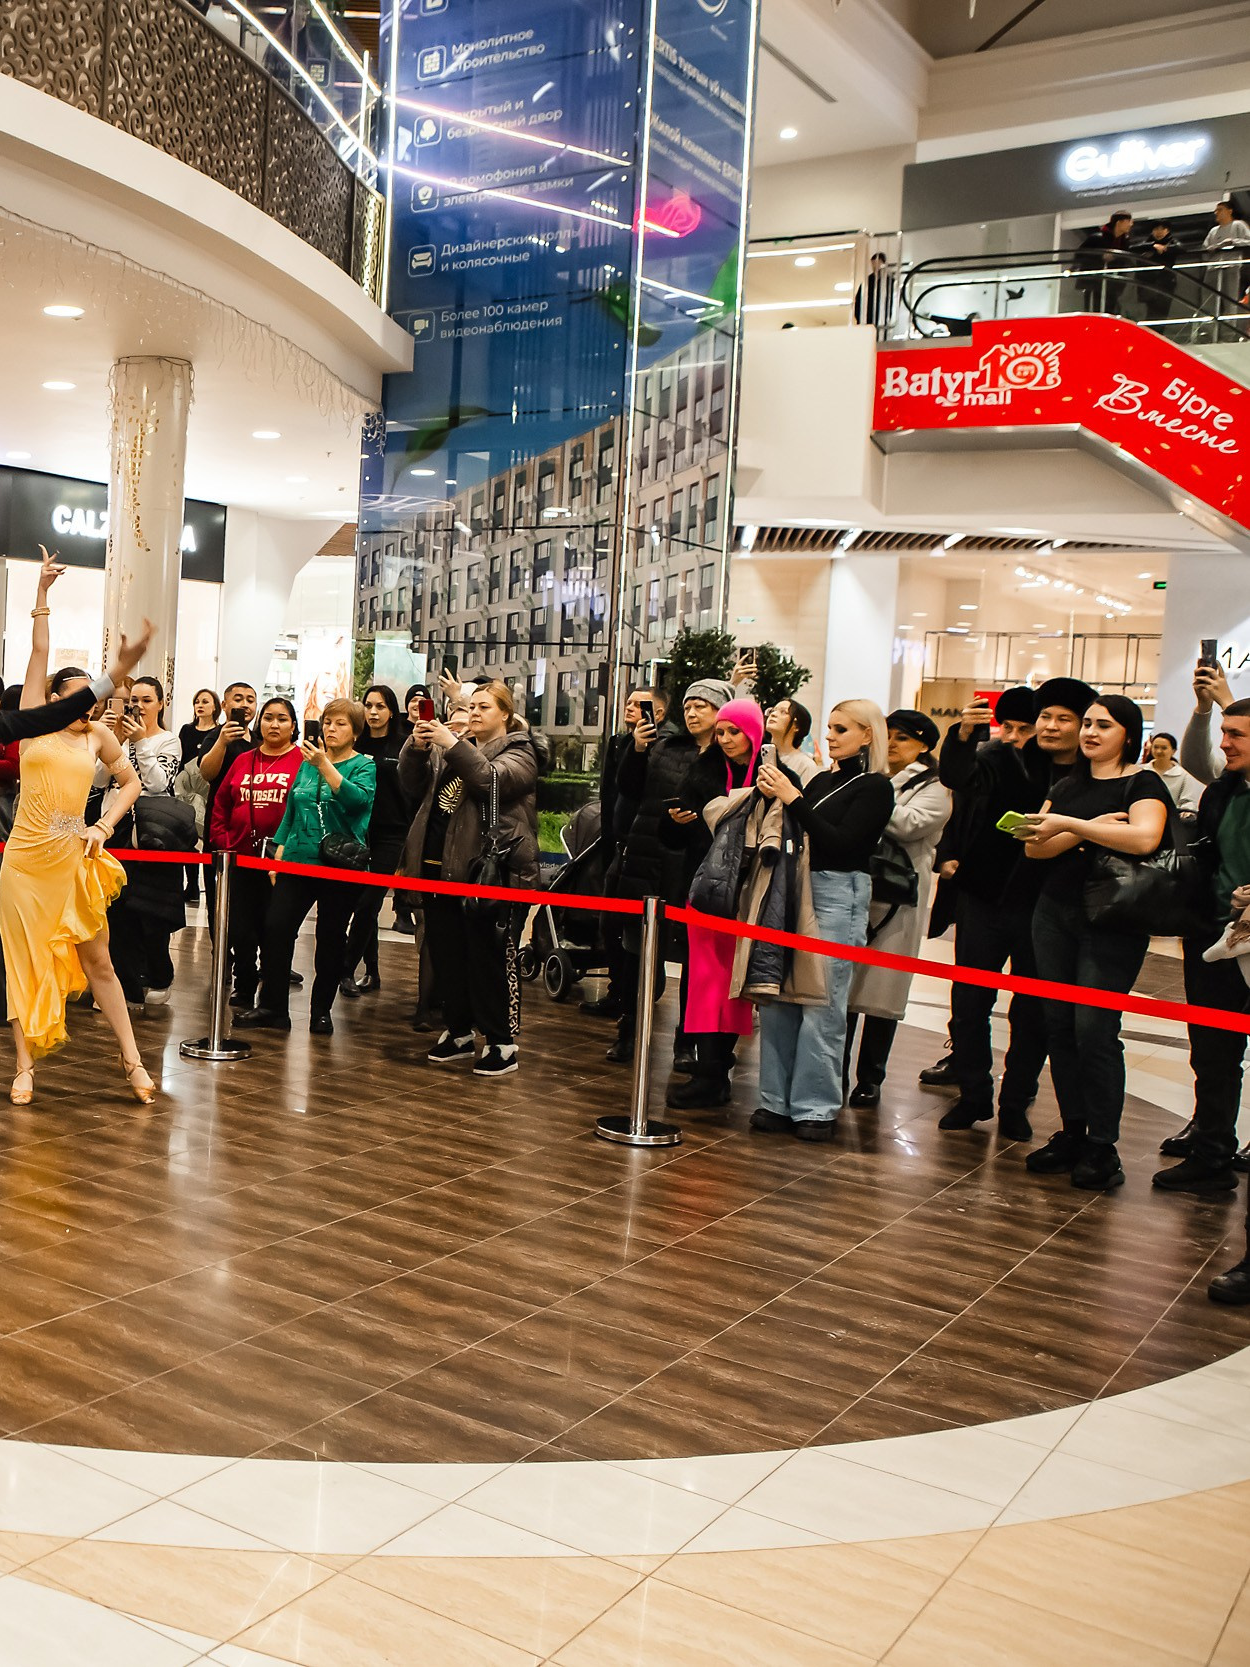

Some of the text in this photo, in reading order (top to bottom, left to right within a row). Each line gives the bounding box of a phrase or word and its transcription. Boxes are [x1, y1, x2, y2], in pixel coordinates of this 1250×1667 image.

[451, 29, 535, 56] Монолитное
[449, 99, 524, 124] крытый и
[447, 109, 563, 140] безосный двор
[1065, 138, 1206, 182] Gulliver
[462, 164, 536, 186] домофония
[539, 163, 548, 174] и
[532, 176, 574, 192] замки
[441, 252, 530, 272] и колясочные
[441, 301, 549, 322] Более 100 камер
[440, 315, 563, 339] видеонаблюдения
[884, 366, 980, 407] Batyr
[963, 390, 1012, 406] mall
[1092, 373, 1240, 454] Вместе
[1162, 378, 1234, 431] Бірге
[240, 773, 290, 787] LOVE
